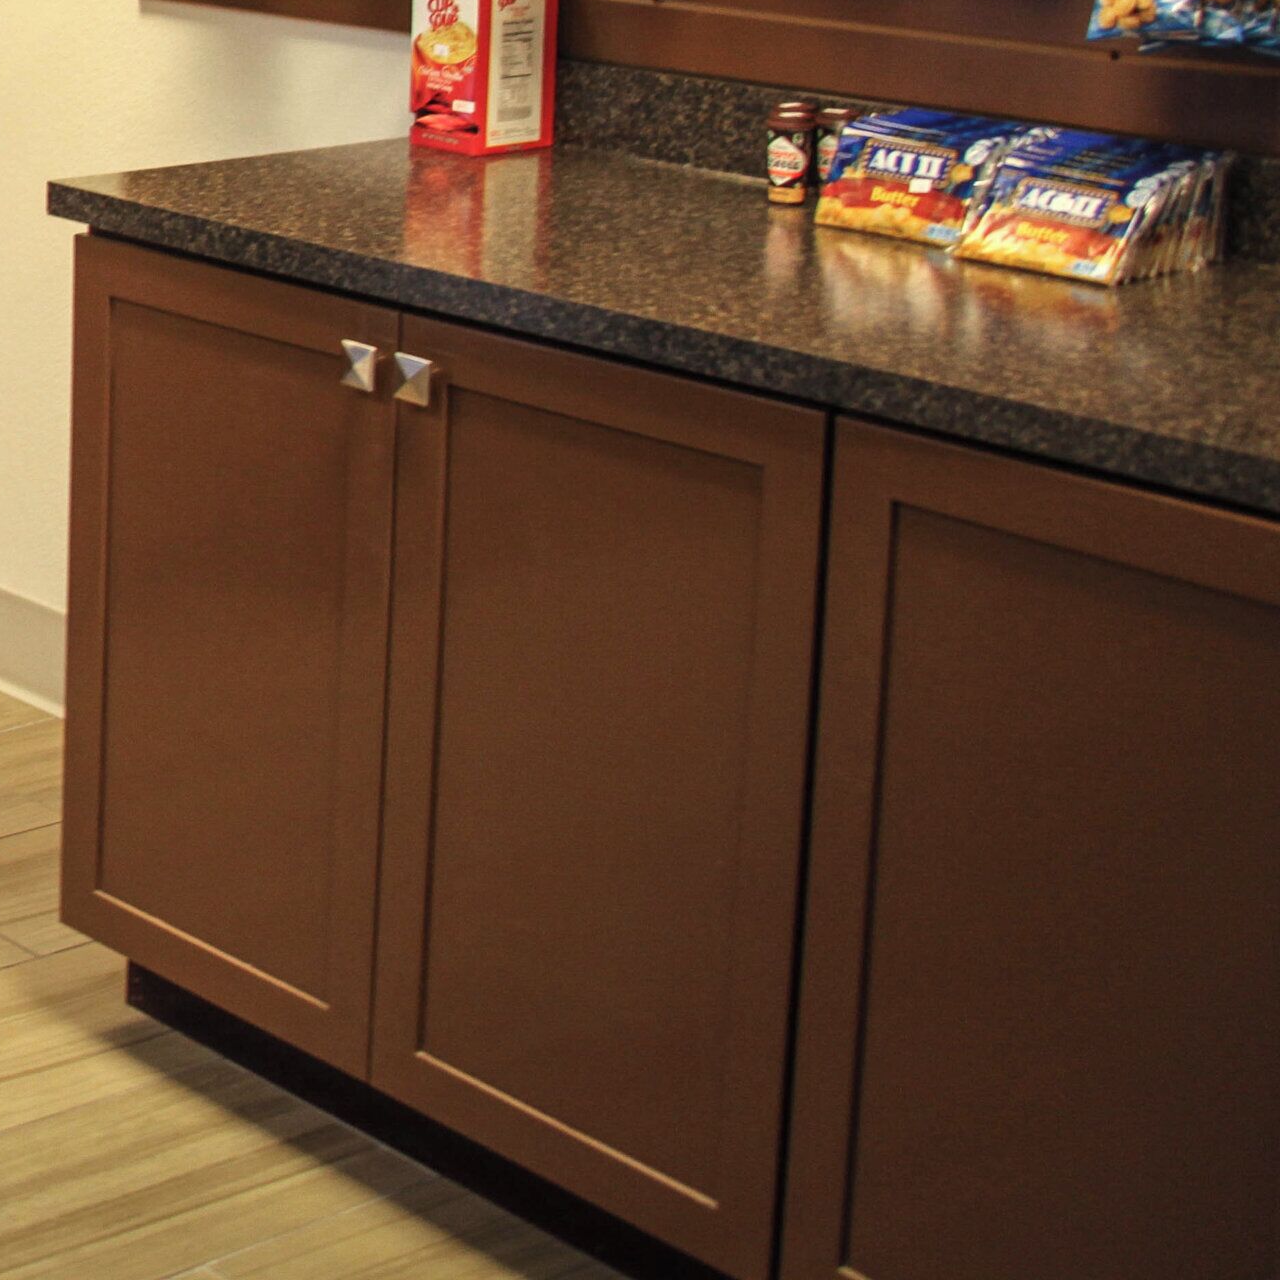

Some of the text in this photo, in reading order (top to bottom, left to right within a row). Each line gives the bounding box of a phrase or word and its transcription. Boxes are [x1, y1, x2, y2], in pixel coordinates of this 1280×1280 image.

[868, 148, 946, 178] ACT II
[871, 185, 920, 207] Butter
